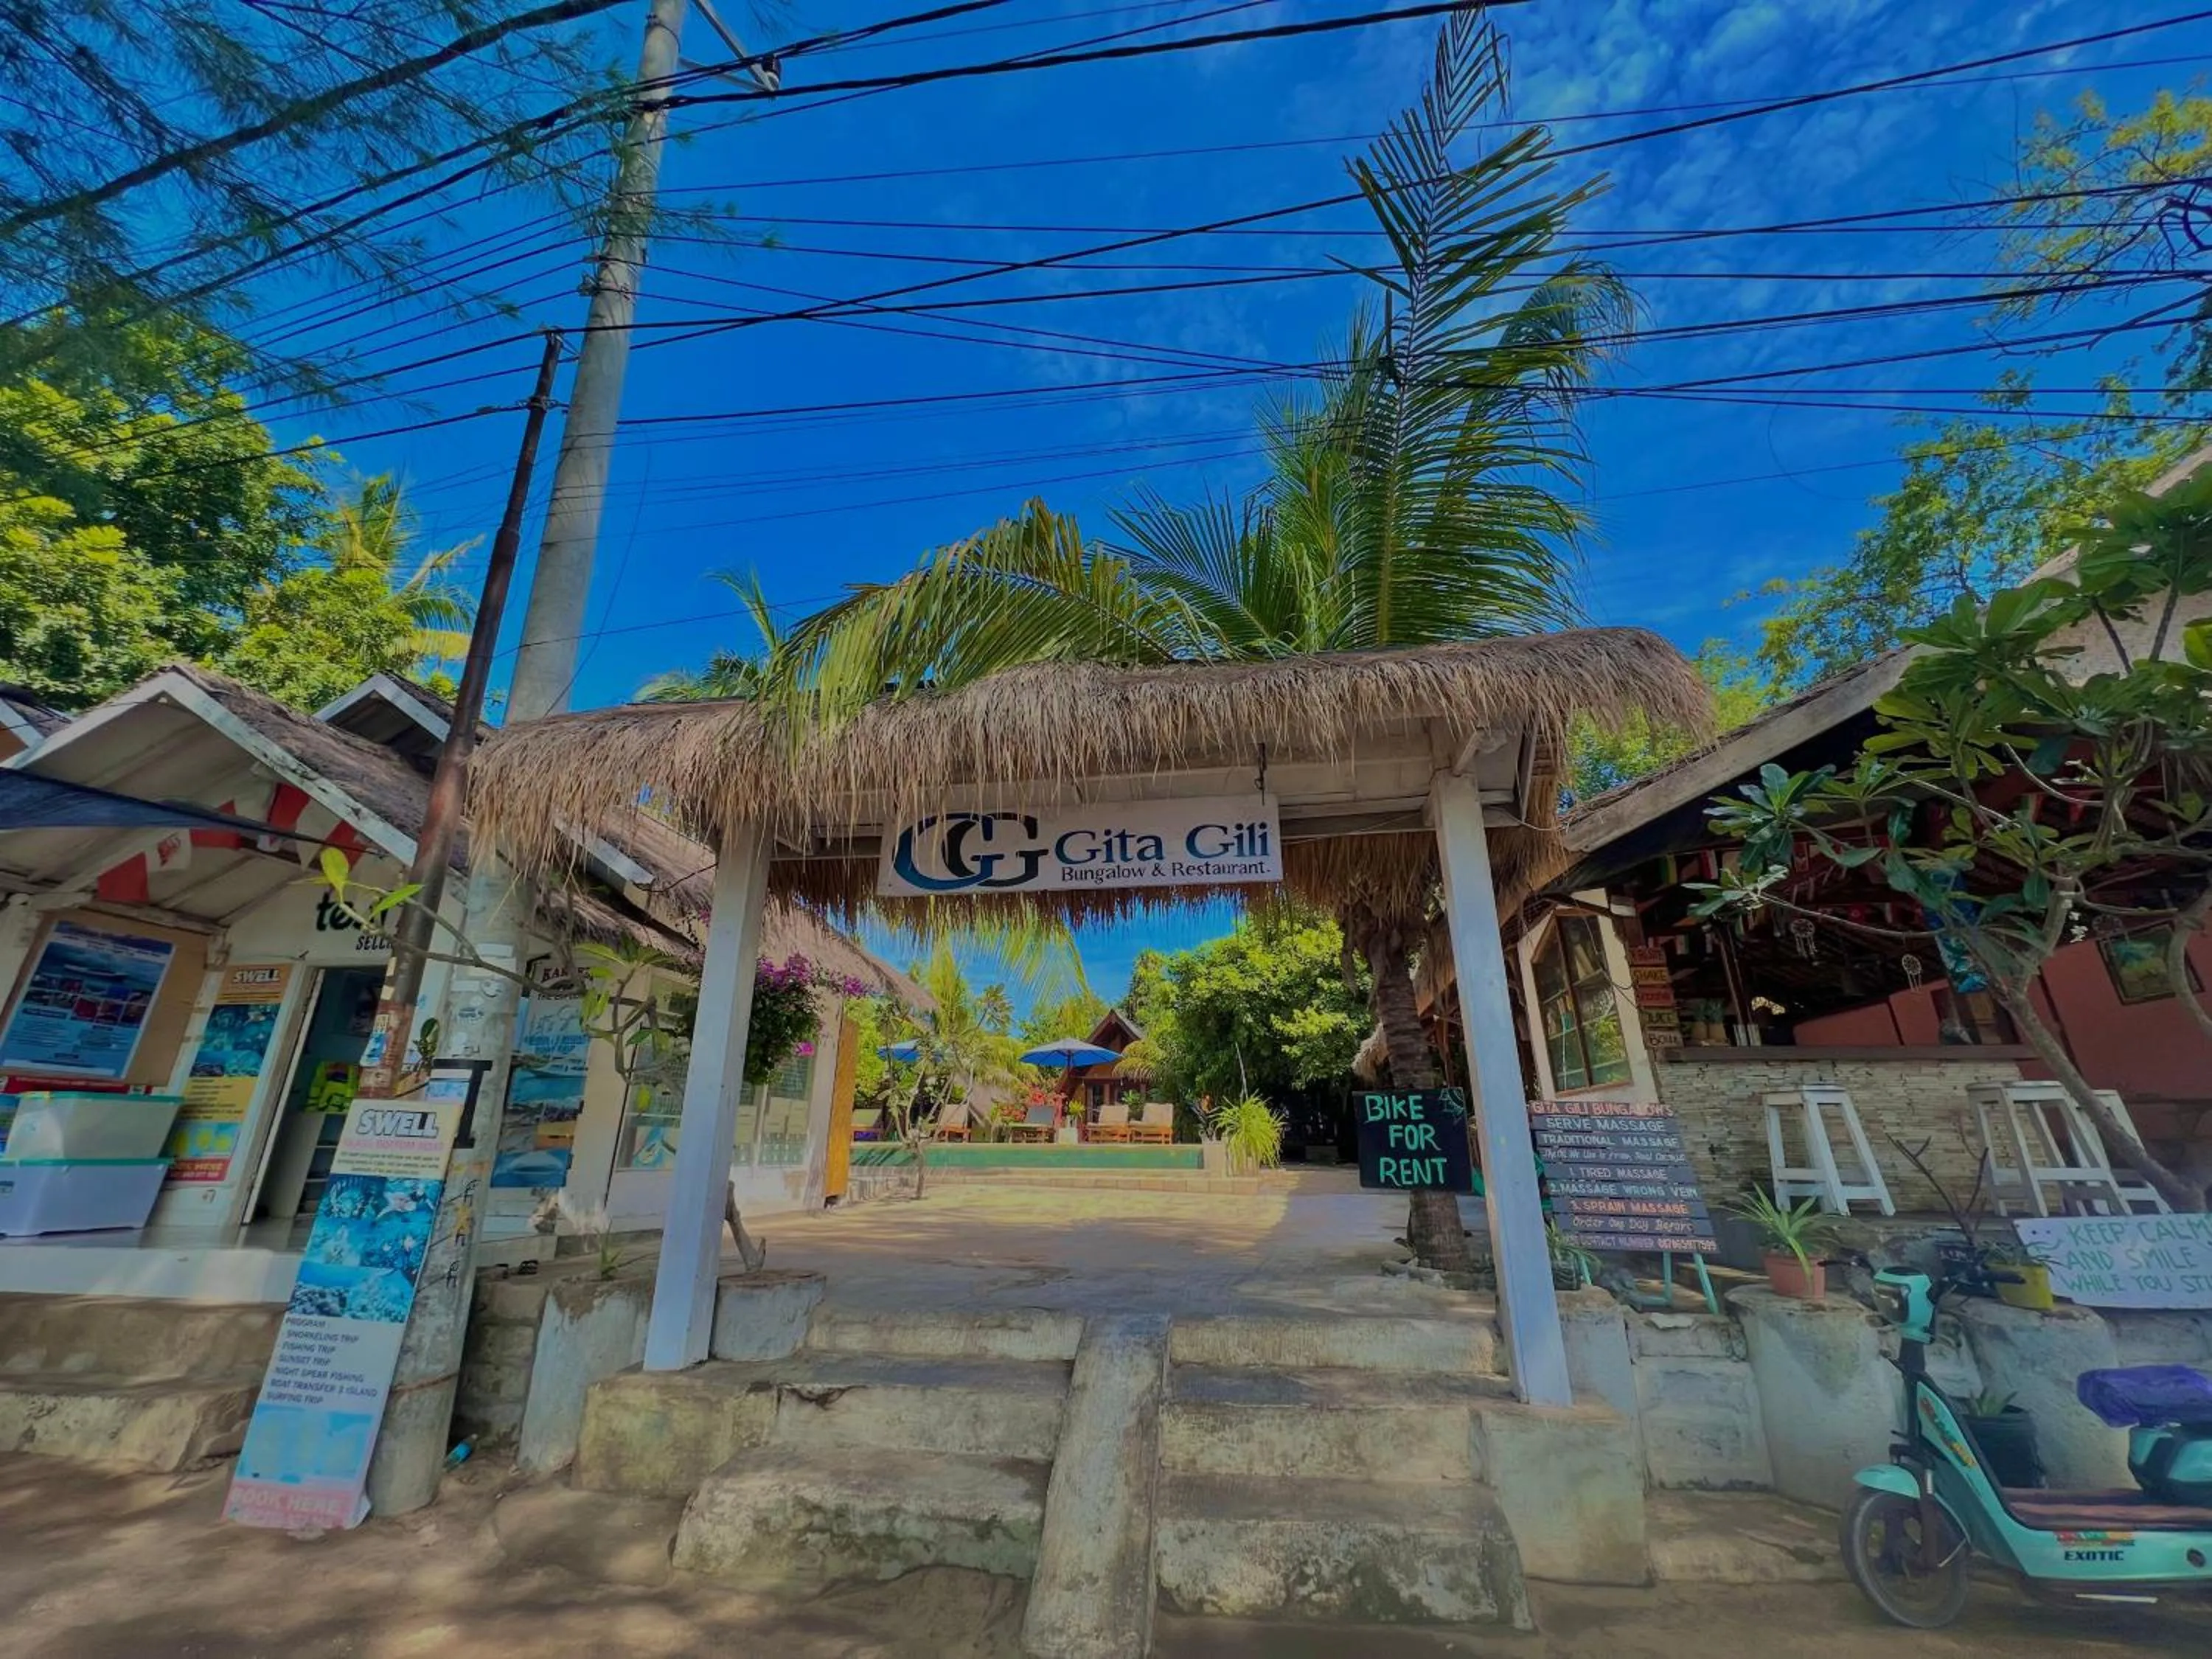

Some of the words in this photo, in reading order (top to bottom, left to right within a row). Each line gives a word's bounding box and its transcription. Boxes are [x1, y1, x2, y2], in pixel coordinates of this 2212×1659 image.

[1055, 828, 1165, 865] Gita
[1185, 821, 1269, 858] Gili
[1062, 861, 1144, 884] Bungalow
[1153, 862, 1166, 877] &
[233, 968, 281, 984] SWELL
[1365, 1094, 1424, 1124] BIKE
[1533, 1102, 1560, 1114] GITA
[1565, 1103, 1588, 1116] GILI
[356, 1109, 439, 1138] SWELL
[1546, 1118, 1591, 1130] SERVE
[1596, 1119, 1666, 1132] MASSAGE
[1389, 1124, 1441, 1151] FOR
[1543, 1133, 1615, 1145] TRADITIONAL
[1621, 1136, 1679, 1148] MASSAGE
[1380, 1157, 1447, 1187] RENT
[1580, 1168, 1611, 1178] TIRED
[1616, 1169, 1668, 1180] MASSAGE
[1623, 1185, 1665, 1197] WRONG
[1631, 1203, 1688, 1214] MASSAGE
[1573, 1218, 1604, 1228] Order
[1629, 1219, 1649, 1231] Day
[2067, 1221, 2126, 1247] KEEP
[2137, 1218, 2211, 1243] CALM
[2067, 1251, 2114, 1271] AND
[2126, 1246, 2198, 1271] SMILE
[2061, 1274, 2126, 1292] WHILE
[2130, 1275, 2173, 1292] YOU
[341, 1334, 360, 1343] TRIP
[282, 1341, 316, 1353] FISHING
[318, 1345, 336, 1354] TRIP
[279, 1354, 311, 1365] SUNSET
[313, 1357, 331, 1366] TRIP
[275, 1366, 299, 1377] NIGHT
[330, 1371, 364, 1383] FISHING
[2065, 1551, 2124, 1562] EXOTIC
